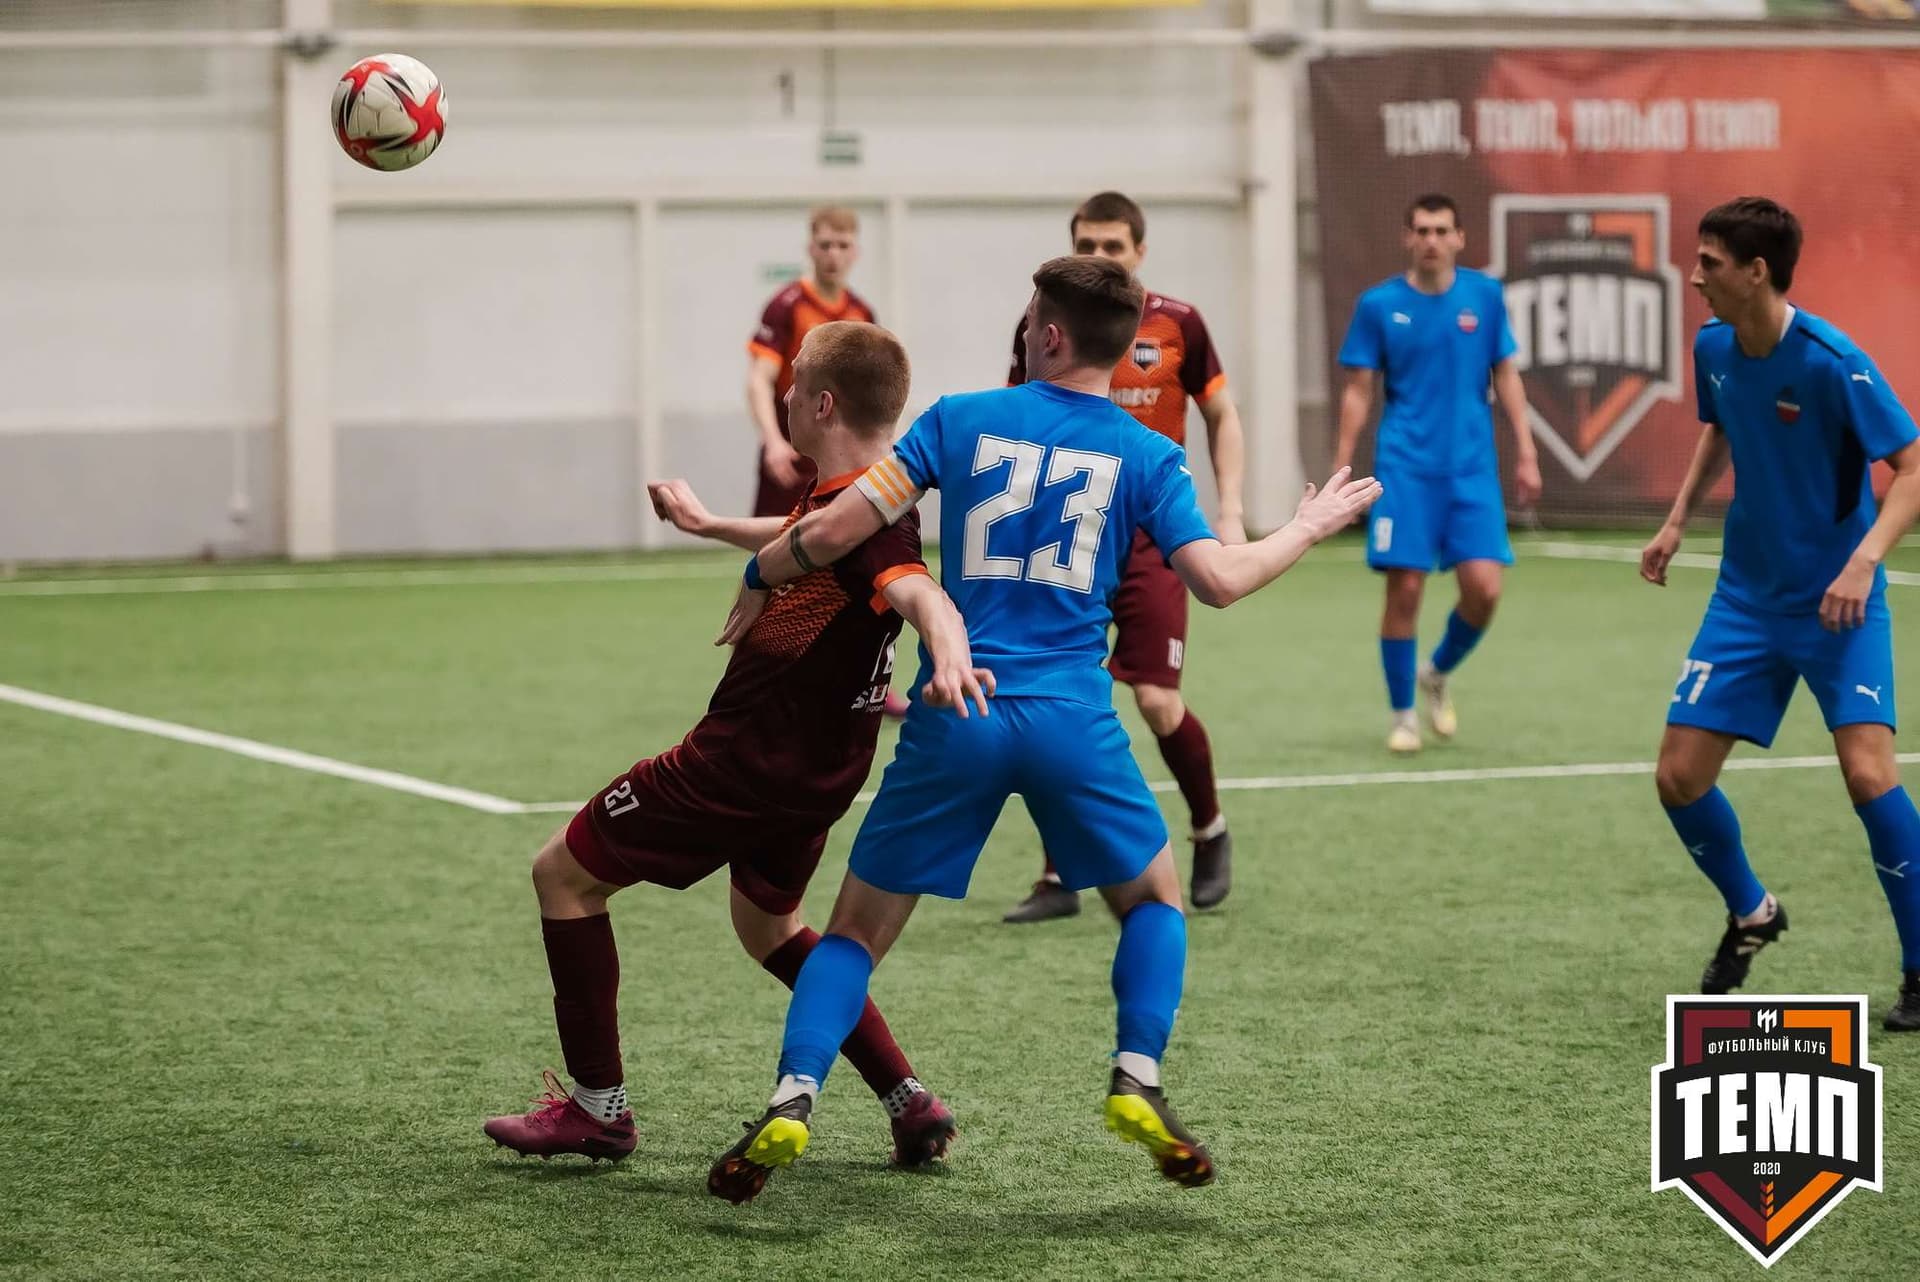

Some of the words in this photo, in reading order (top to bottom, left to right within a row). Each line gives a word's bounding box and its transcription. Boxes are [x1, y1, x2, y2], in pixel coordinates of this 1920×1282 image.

[1503, 272, 1664, 371] ТЕМП
[961, 433, 1122, 595] 23
[604, 780, 640, 818] 27
